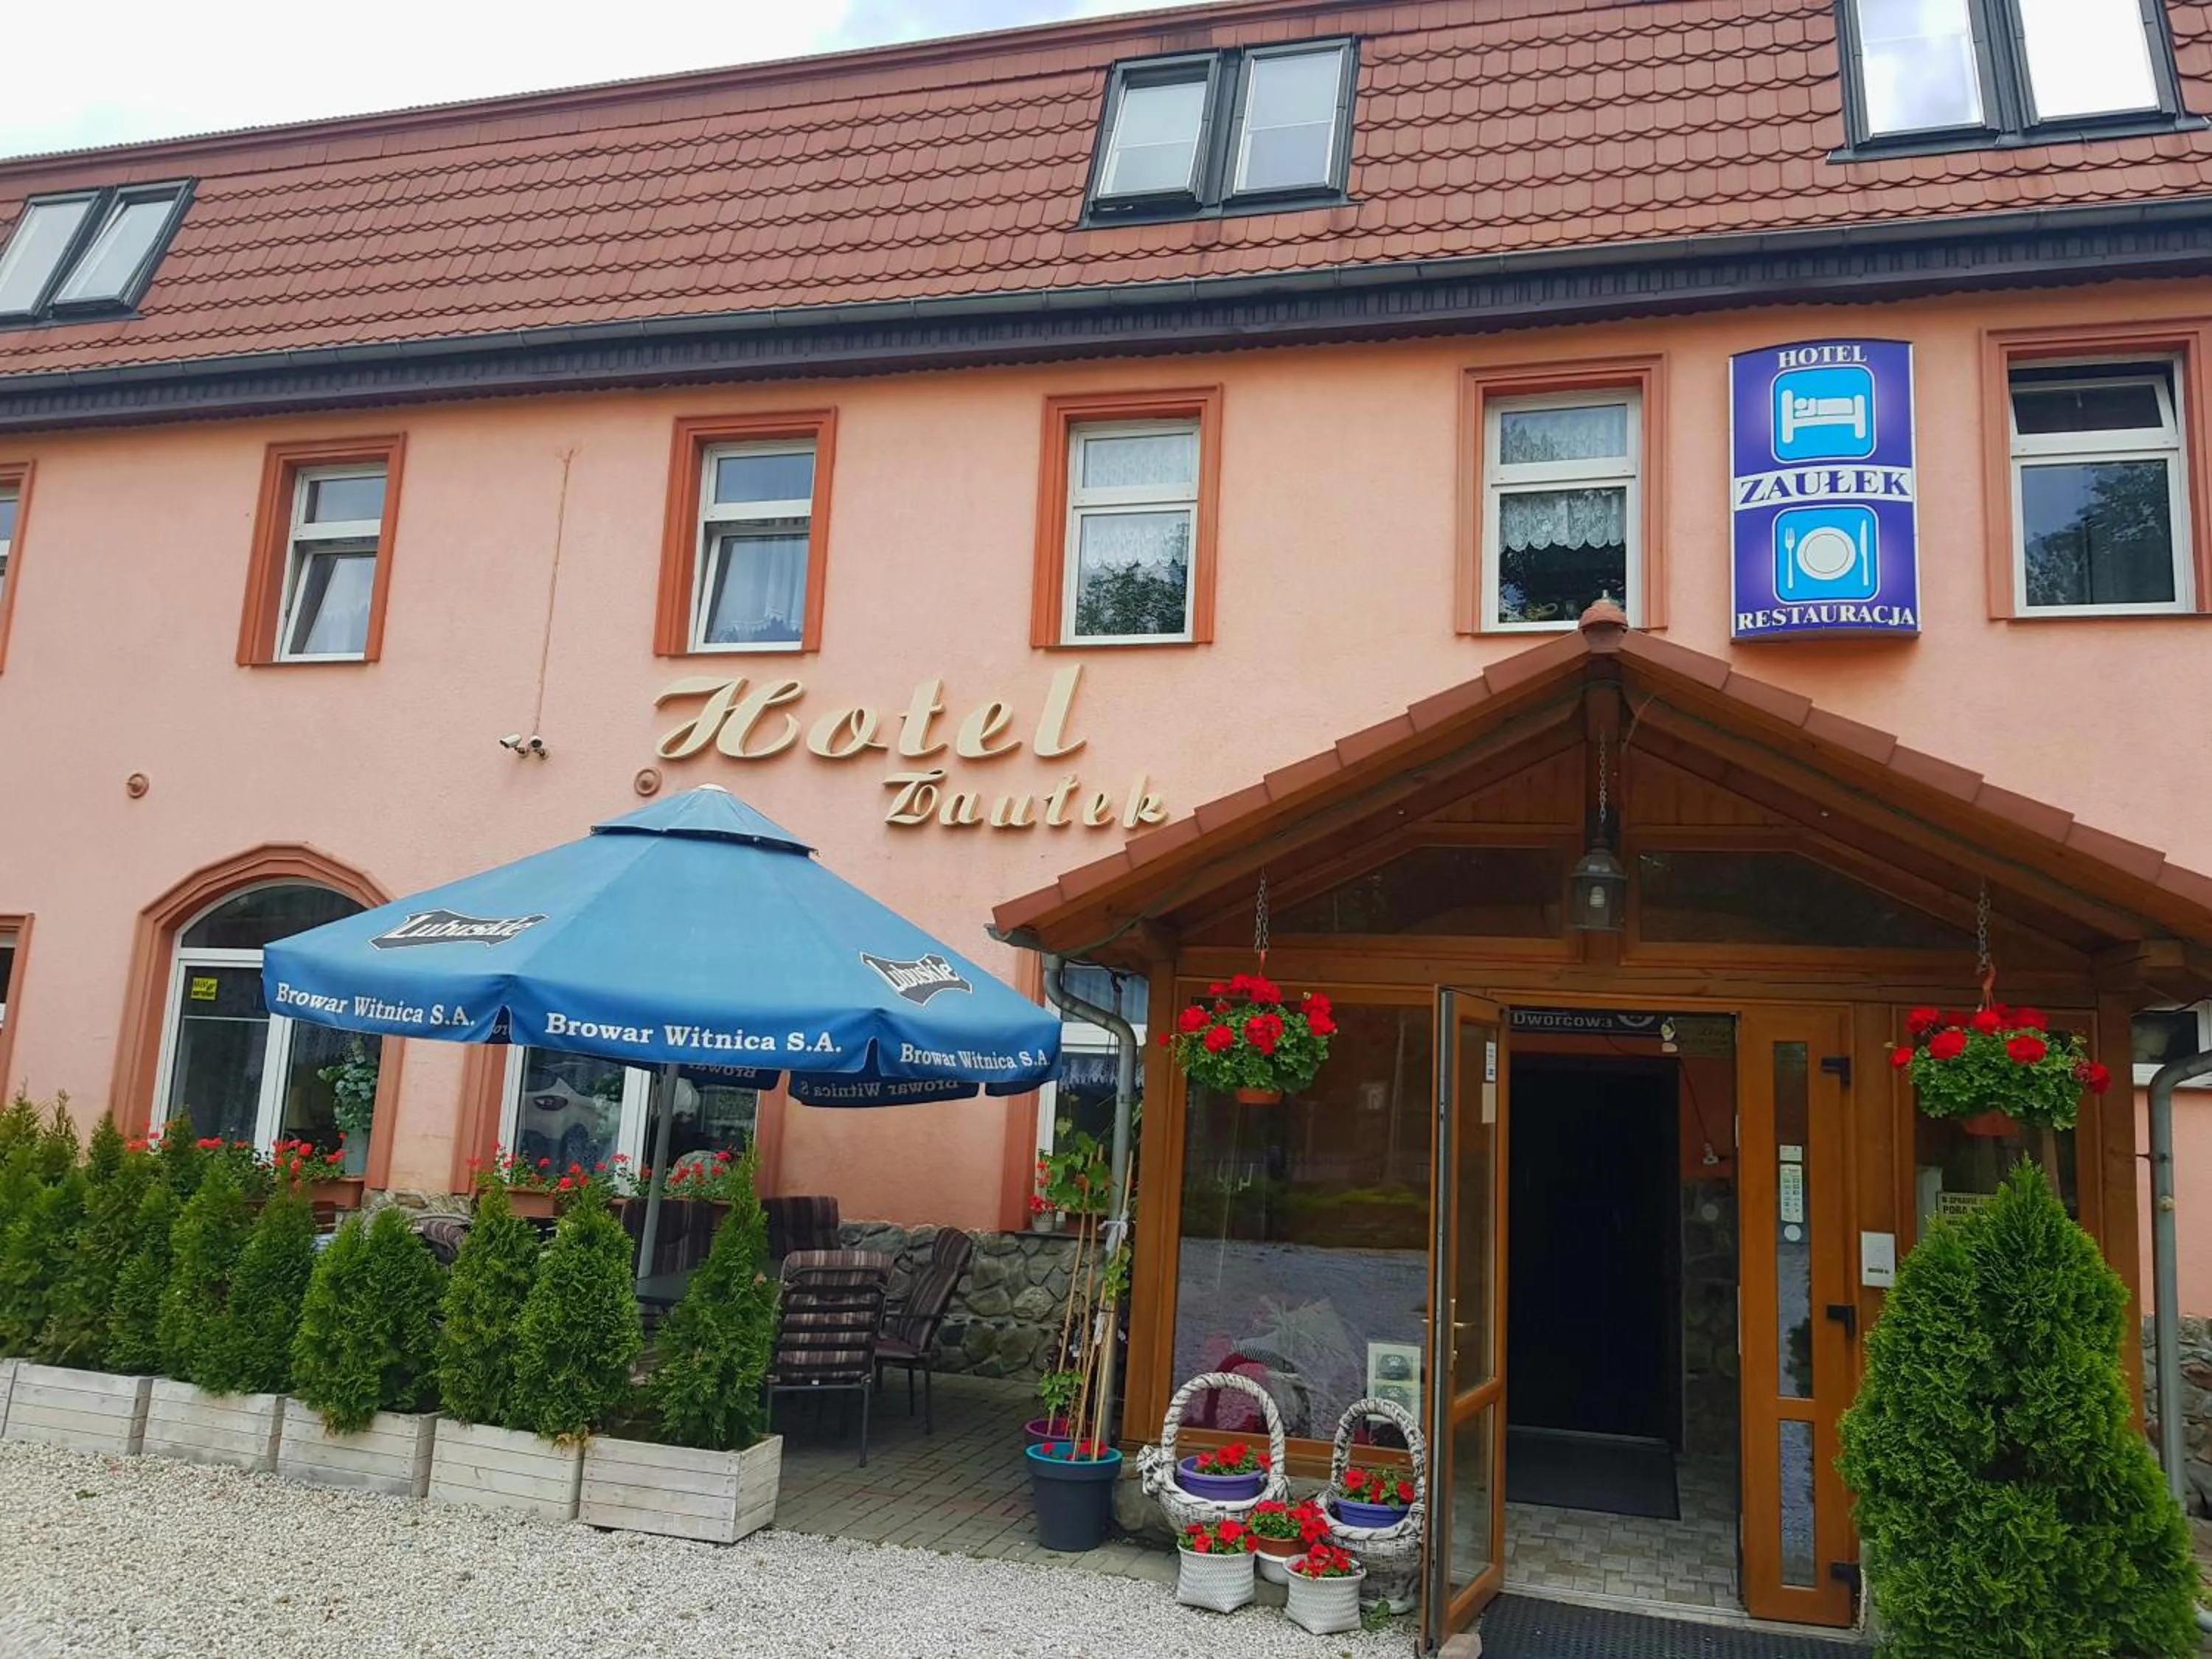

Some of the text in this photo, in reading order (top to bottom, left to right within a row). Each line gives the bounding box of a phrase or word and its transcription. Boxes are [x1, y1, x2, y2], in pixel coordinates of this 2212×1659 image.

[1777, 345, 1868, 369] HOTEL
[1739, 470, 1911, 505] ZAUŁEK
[1737, 604, 1916, 631] RESTAURACJA
[653, 663, 1088, 760] Hotel
[276, 981, 476, 1028] Browar Witnica S.A.
[1513, 1012, 1613, 1028] Dworcowa
[545, 1012, 842, 1053] Browar Witnica S.A.
[900, 1042, 957, 1068] Browar
[958, 1048, 1016, 1070] Witnica
